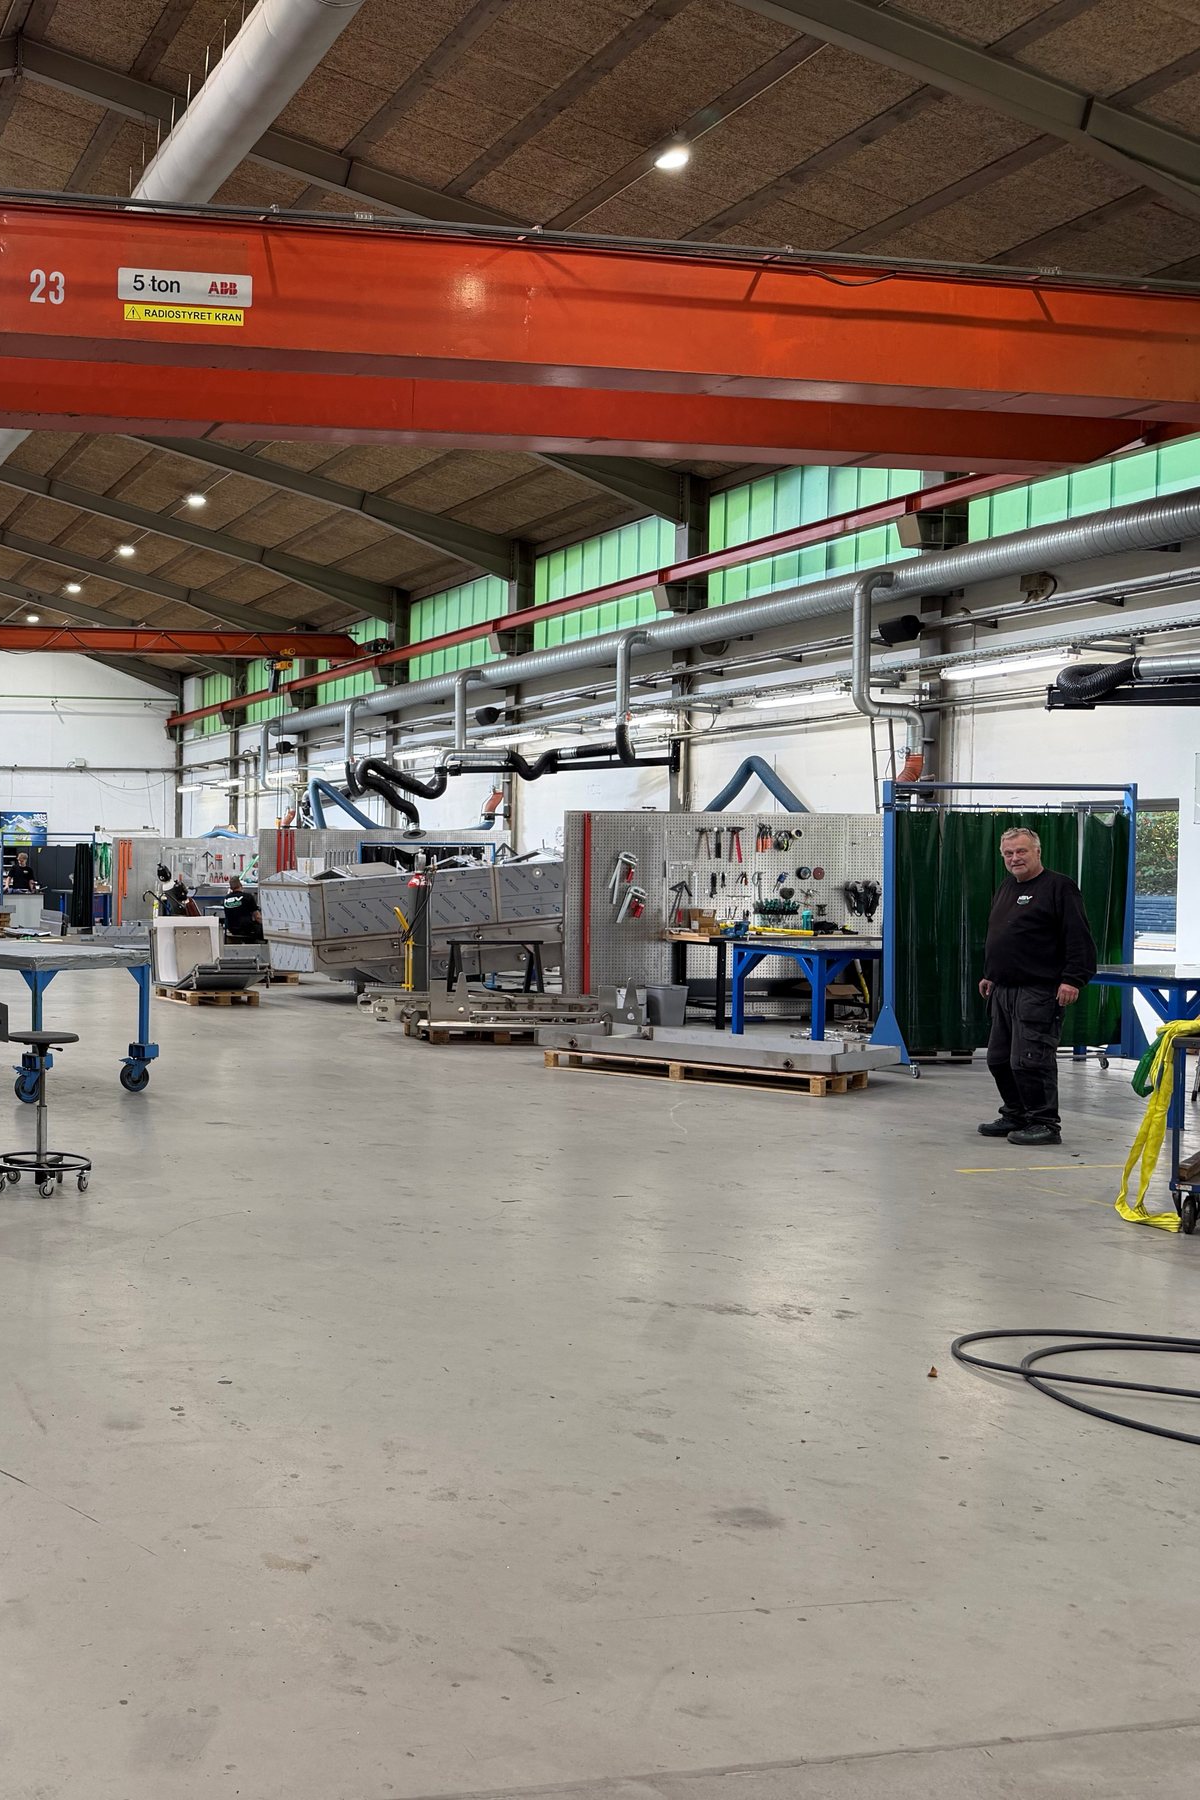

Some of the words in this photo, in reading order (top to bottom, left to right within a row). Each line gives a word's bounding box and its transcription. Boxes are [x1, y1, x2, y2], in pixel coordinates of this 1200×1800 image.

[29, 269, 65, 305] 23
[133, 274, 145, 292] 5
[152, 275, 181, 294] ton
[208, 281, 238, 295] ABB
[144, 308, 212, 321] RADIOSTYRET
[214, 312, 242, 322] KRAN
